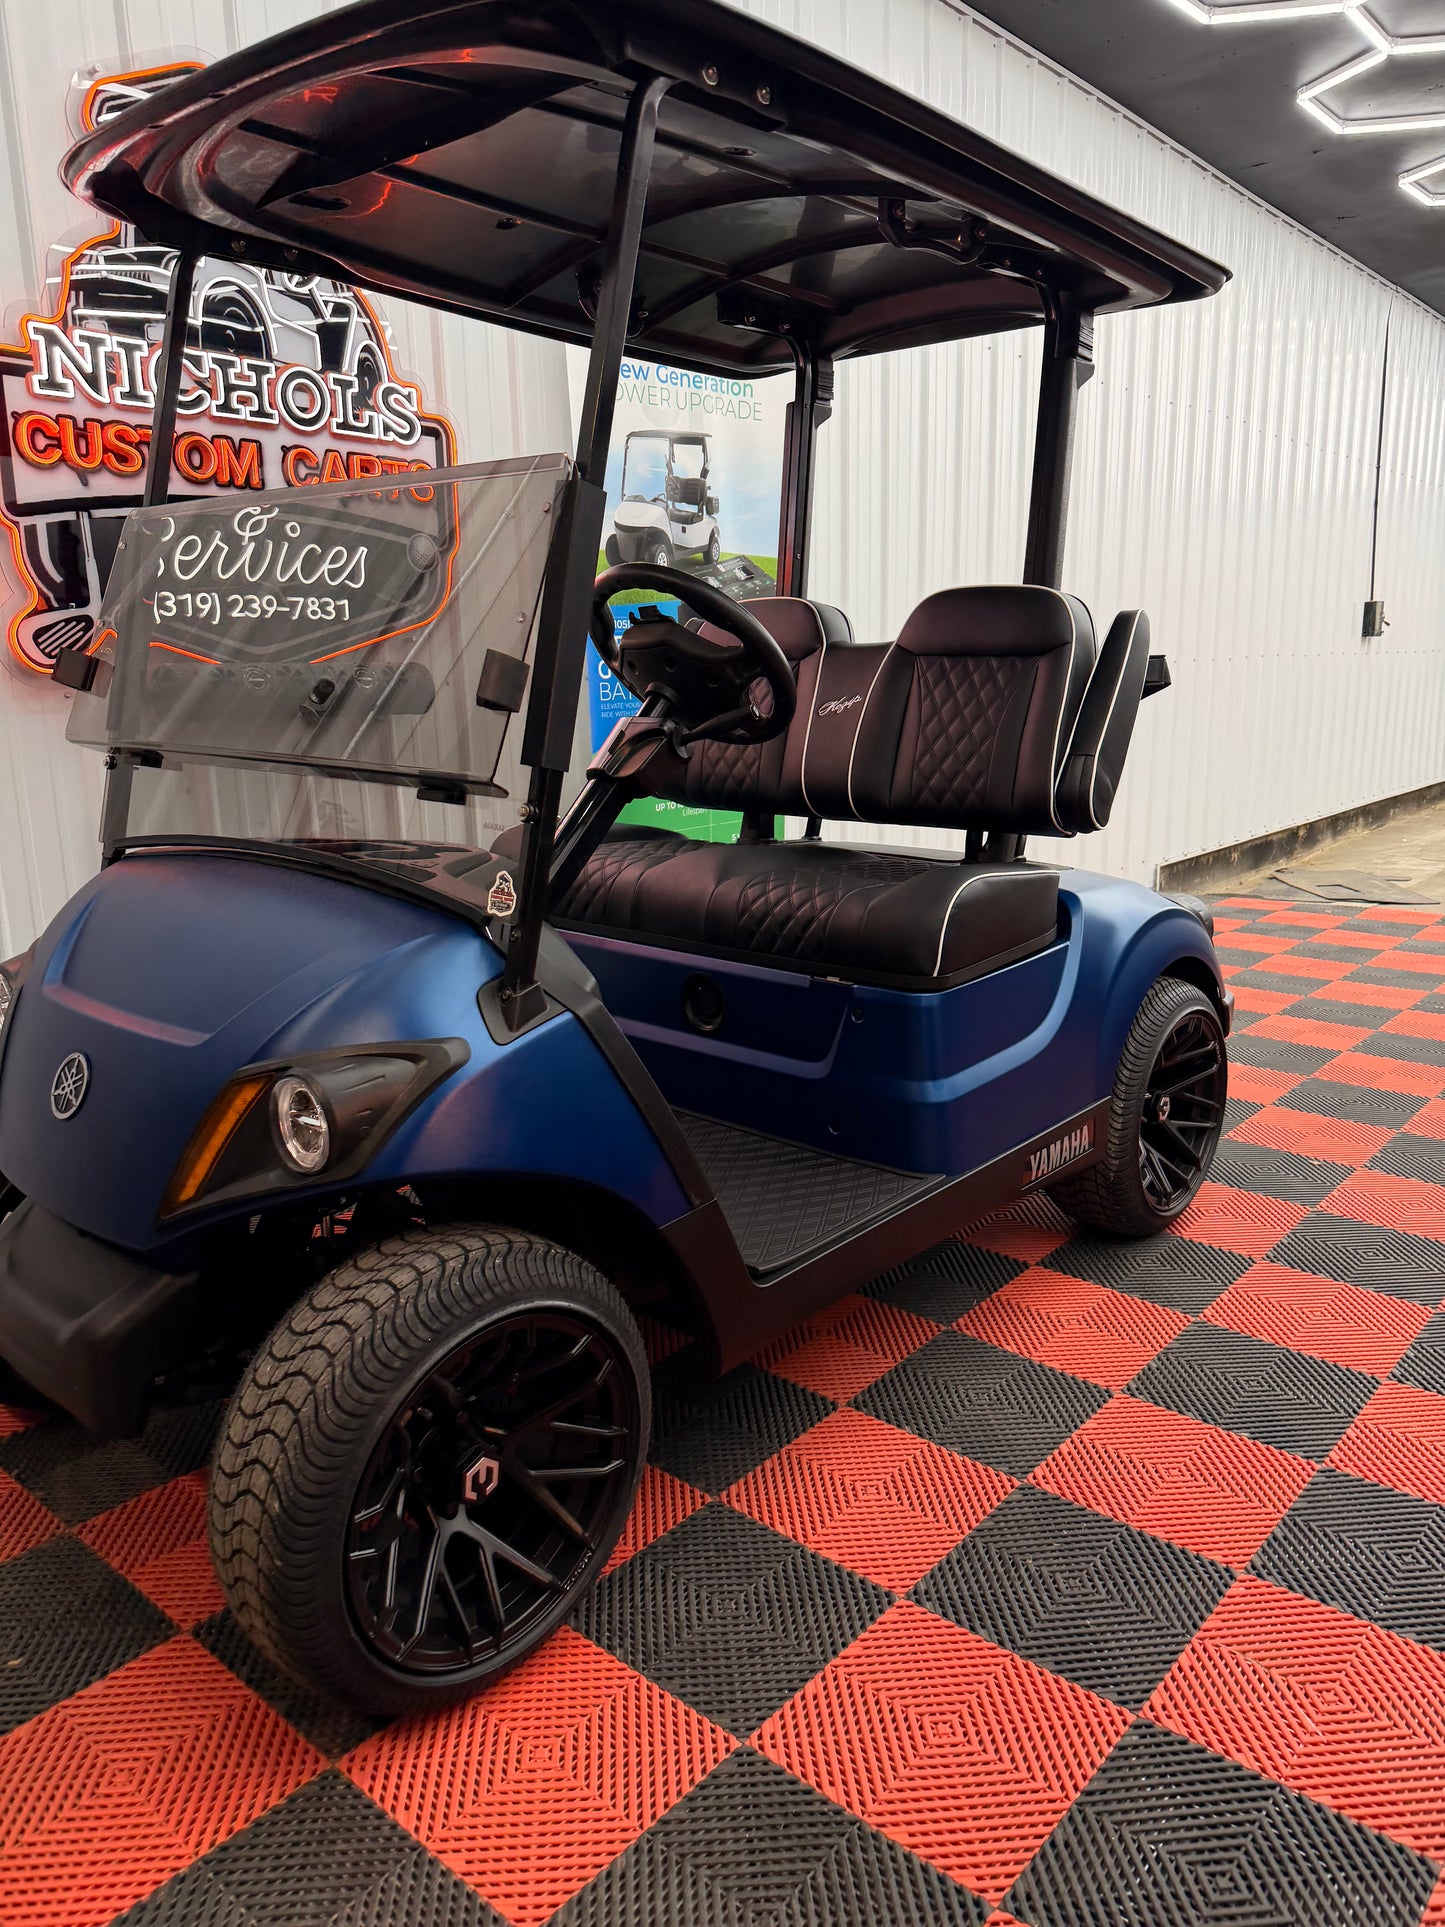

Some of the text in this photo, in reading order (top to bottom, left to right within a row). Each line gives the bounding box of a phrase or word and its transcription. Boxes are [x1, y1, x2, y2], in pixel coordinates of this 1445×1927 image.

[28, 321, 423, 446] NICHOLS
[620, 363, 753, 398] ew Generation
[616, 382, 763, 421] OWER UPGRADE
[12, 411, 265, 490] CUSOM
[234, 506, 280, 546] &
[153, 590, 350, 625] (319) 239-7831
[601, 702, 624, 711] ELEVATE
[601, 710, 614, 718] RIDE
[615, 709, 630, 717] WITH
[655, 803, 666, 811] UP
[667, 801, 676, 810] TO
[1030, 1124, 1089, 1181] YAMAHA
